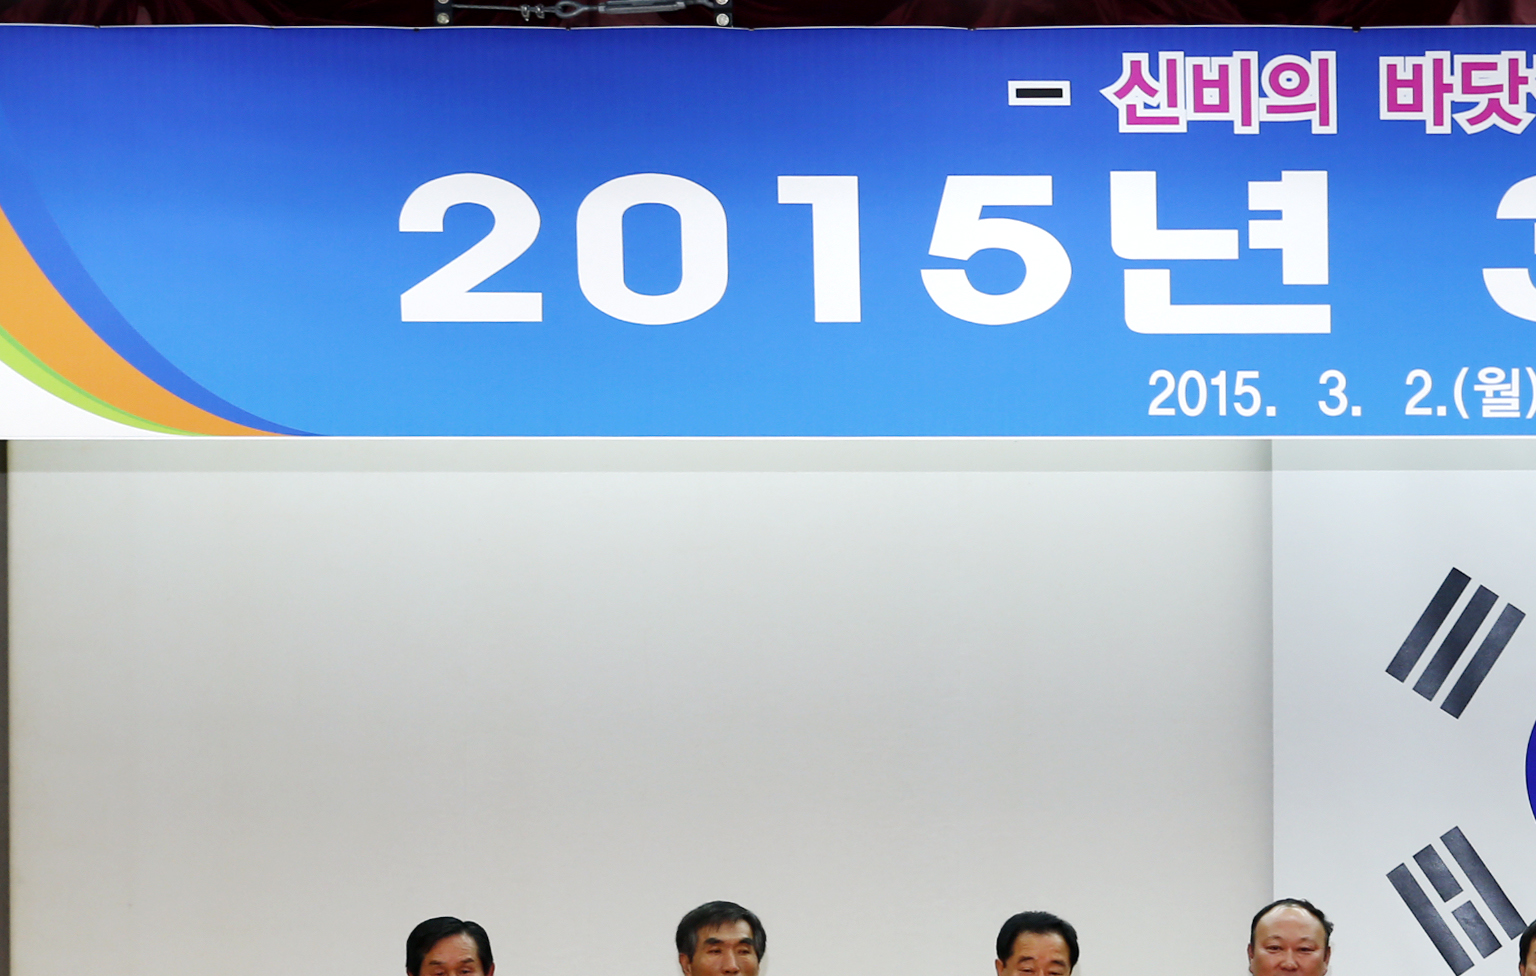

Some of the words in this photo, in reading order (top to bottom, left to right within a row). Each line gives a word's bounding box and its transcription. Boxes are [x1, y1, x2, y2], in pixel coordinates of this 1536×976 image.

[1100, 51, 1337, 134] 신비의
[399, 171, 1331, 334] 2015년
[1148, 370, 1276, 417] 2015.
[1318, 369, 1361, 416] 3.
